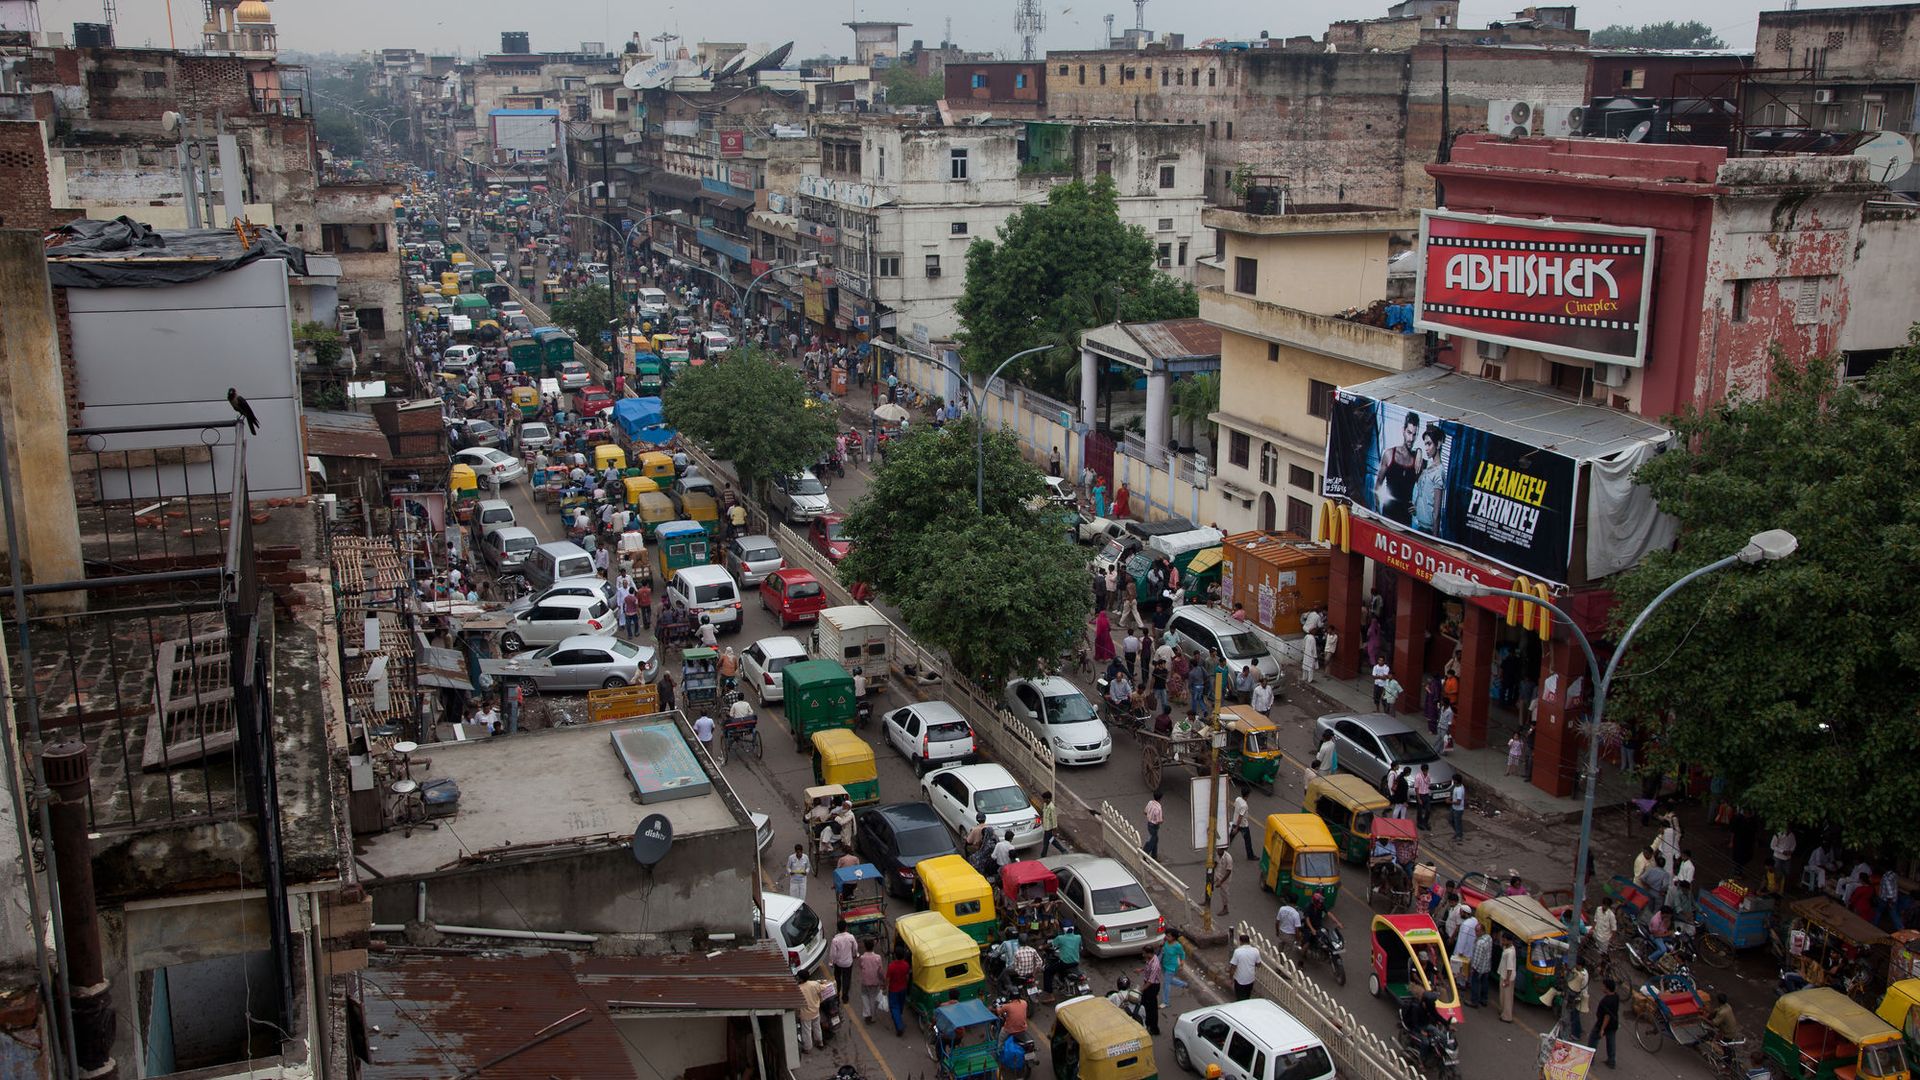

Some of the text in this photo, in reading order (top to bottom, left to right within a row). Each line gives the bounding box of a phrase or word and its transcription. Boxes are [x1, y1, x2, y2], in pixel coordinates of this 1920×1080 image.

[1445, 253, 1619, 299] ABHISHEK
[1564, 299, 1619, 316] Cineplex
[1473, 460, 1547, 507] LAFANGEY
[1467, 488, 1540, 535] PARINDEY
[1374, 532, 1480, 584] McDonald's
[1386, 556, 1409, 570] FAMILY
[1415, 568, 1433, 580] REST
